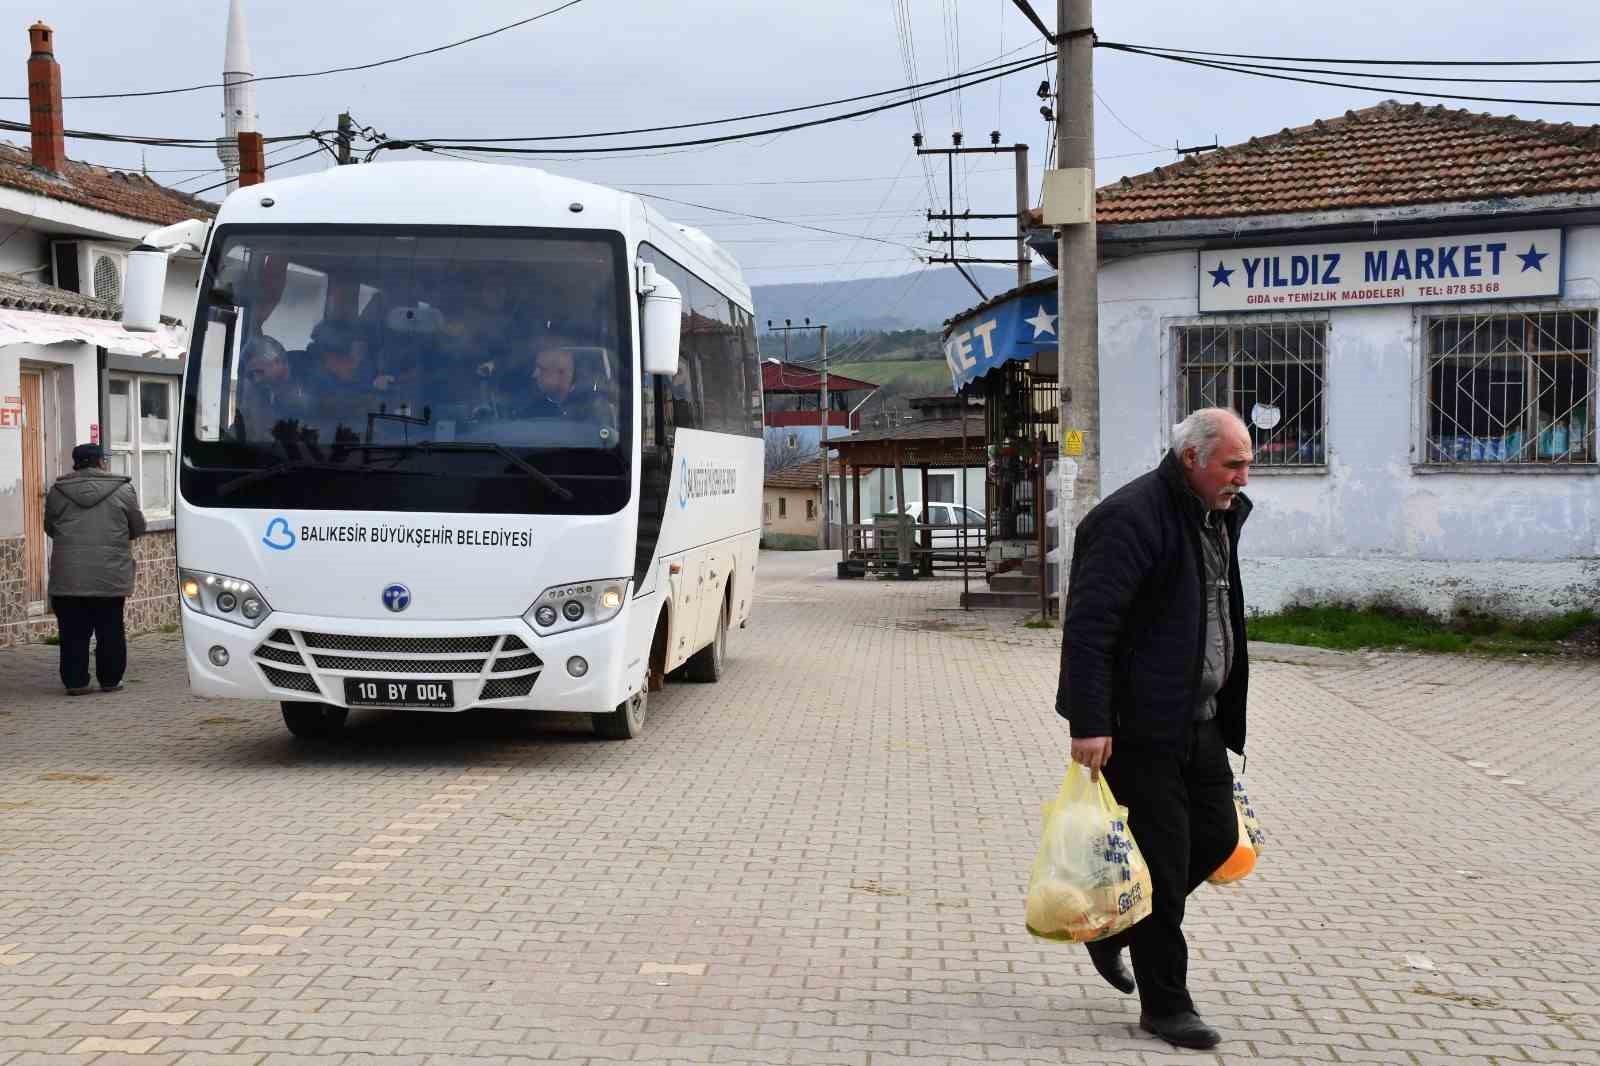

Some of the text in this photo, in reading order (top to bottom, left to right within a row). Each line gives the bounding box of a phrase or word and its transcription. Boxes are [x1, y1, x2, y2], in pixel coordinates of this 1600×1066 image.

[1241, 242, 1507, 289] YILDIZ MARKET
[1247, 294, 1271, 305] GIDA
[1287, 291, 1337, 303] TEMİZLİK
[1342, 287, 1404, 300] MADDELERİ
[1418, 286, 1443, 296] TEL:
[1446, 285, 1466, 295] 878
[1469, 284, 1482, 294] 53
[1486, 282, 1500, 293] 68
[301, 523, 532, 548] BALIKESİR BÜYÜKŞEHİR BELEDİYESİ
[358, 683, 447, 701] 10 BY 004
